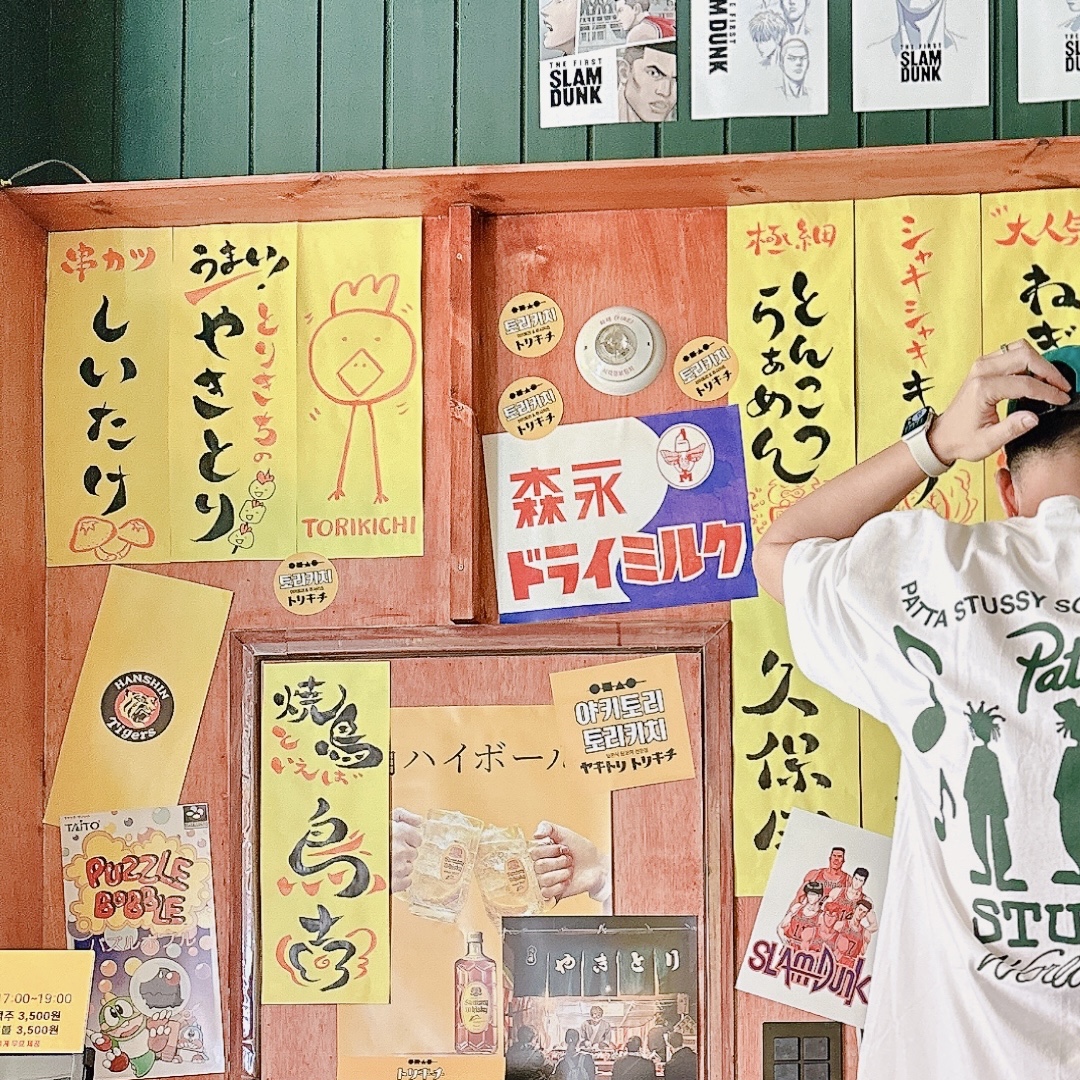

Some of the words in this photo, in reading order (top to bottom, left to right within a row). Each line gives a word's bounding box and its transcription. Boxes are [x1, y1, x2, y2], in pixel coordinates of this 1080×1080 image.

[709, 20, 728, 74] DUNK
[900, 50, 942, 67] SLAM
[574, 58, 602, 66] FIRST
[901, 66, 942, 82] DUNK
[550, 67, 602, 88] SLAM
[550, 86, 602, 107] DUNK
[746, 220, 837, 256] 極細
[61, 242, 156, 282] 串カツ
[515, 330, 555, 351] トリキチ
[253, 303, 279, 463] とりきちの
[695, 369, 732, 397] トリキチ
[789, 271, 833, 474] とんこつ
[79, 295, 137, 515] しいたけ
[190, 305, 244, 543] やきとり
[517, 412, 555, 435] トリキチ
[510, 459, 627, 528] 森永
[301, 516, 416, 537] TORIKICHI
[507, 520, 746, 600] ドライミルク
[288, 592, 328, 606] トリキチ
[901, 581, 948, 628] PATTA
[954, 590, 1047, 622] STUSSY
[114, 672, 169, 700] HANSHIN
[574, 689, 665, 726] 야키토리
[106, 716, 157, 742] Tigers
[582, 717, 668, 754] 토리키치
[580, 760, 627, 774] ヤキトリ
[631, 748, 677, 770] トリキチ
[86, 849, 194, 892] PUZZLE
[94, 886, 187, 926] BOBBLE
[555, 949, 679, 974] やきとり
[748, 940, 816, 989] SLAM
[809, 942, 873, 1007] DUNK
[0, 993, 72, 1004] 7:00~19:00
[18, 1010, 61, 1021] 3,500원
[16, 1025, 59, 1035] 3,500원
[397, 1067, 445, 1080] トリキチ
